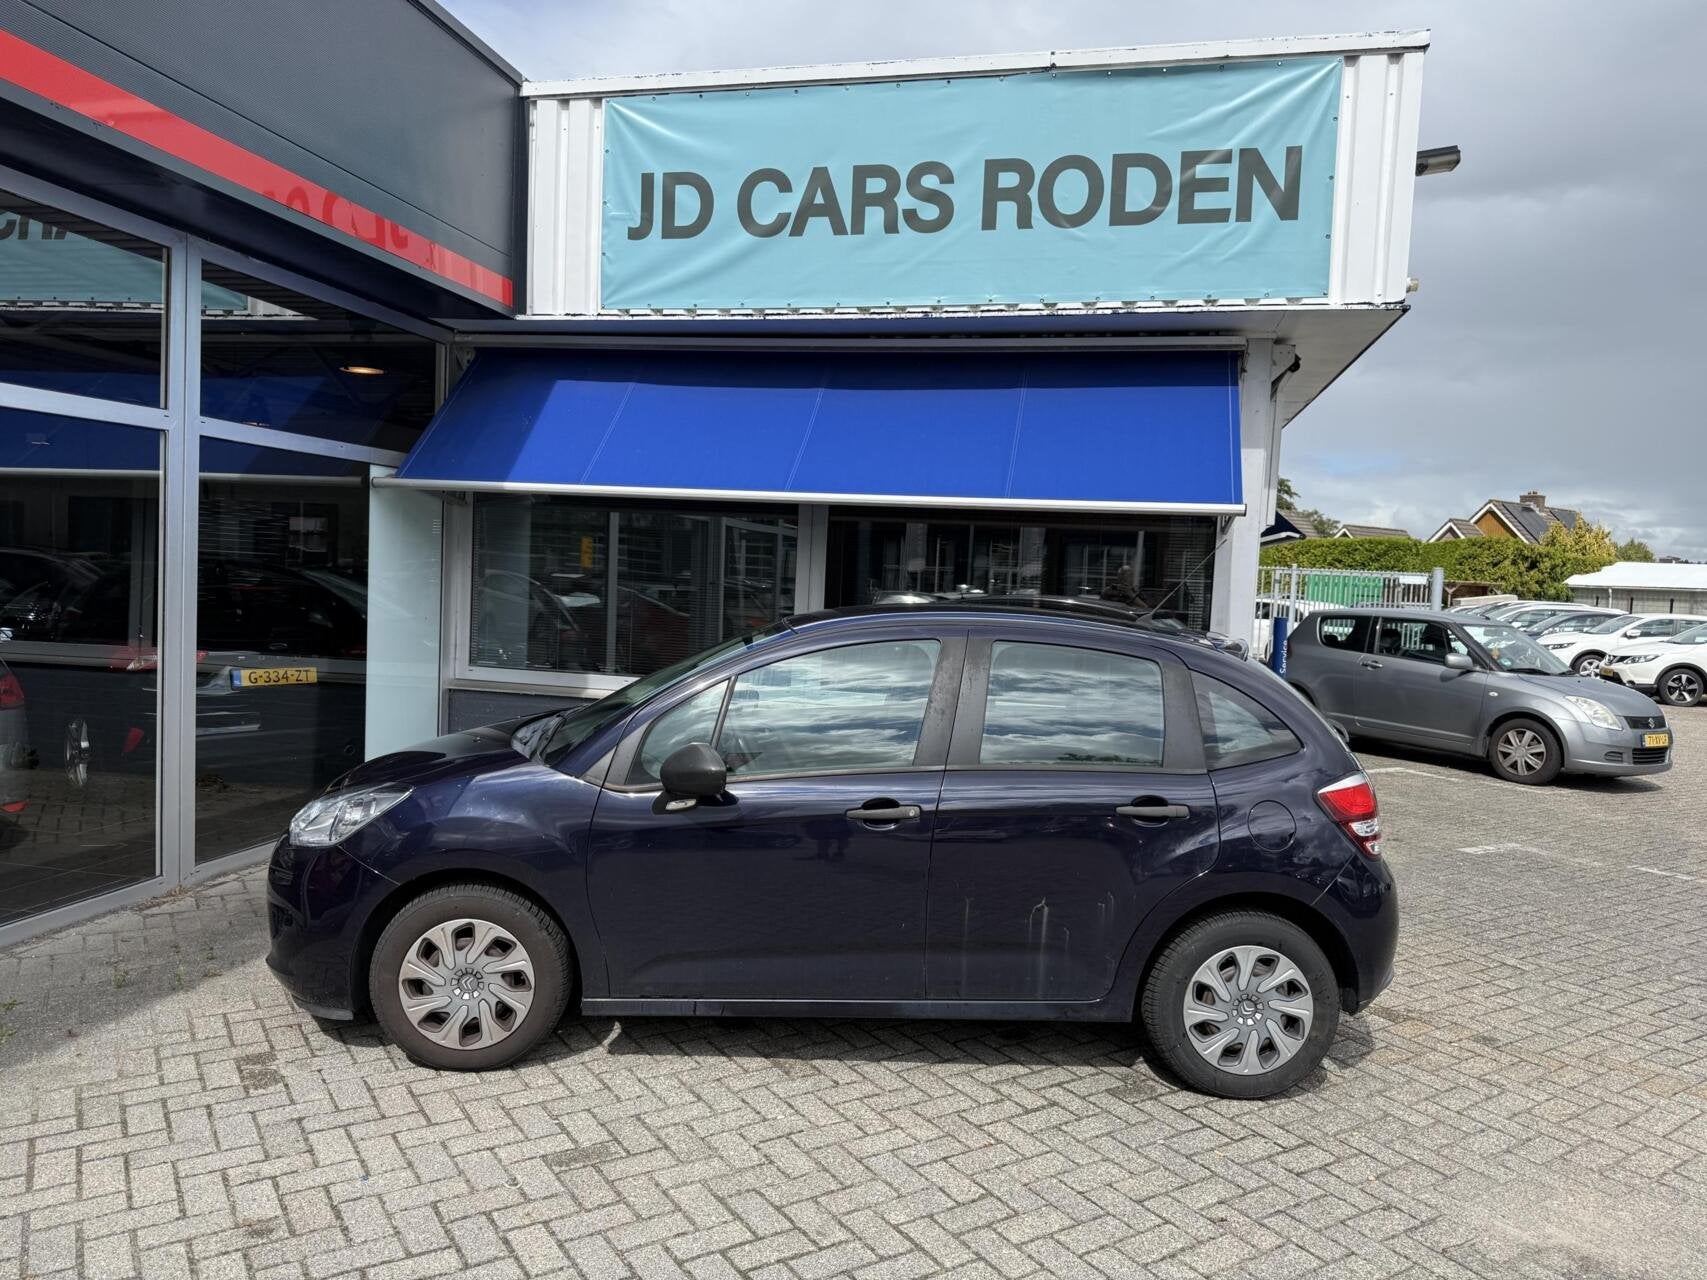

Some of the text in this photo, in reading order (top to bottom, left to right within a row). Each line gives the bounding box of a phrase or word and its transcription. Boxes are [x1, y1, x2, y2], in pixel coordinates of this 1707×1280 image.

[628, 146, 1303, 240] JD CARS RODEN
[1280, 640, 1288, 674] Service
[248, 669, 311, 684] G-334-ZT
